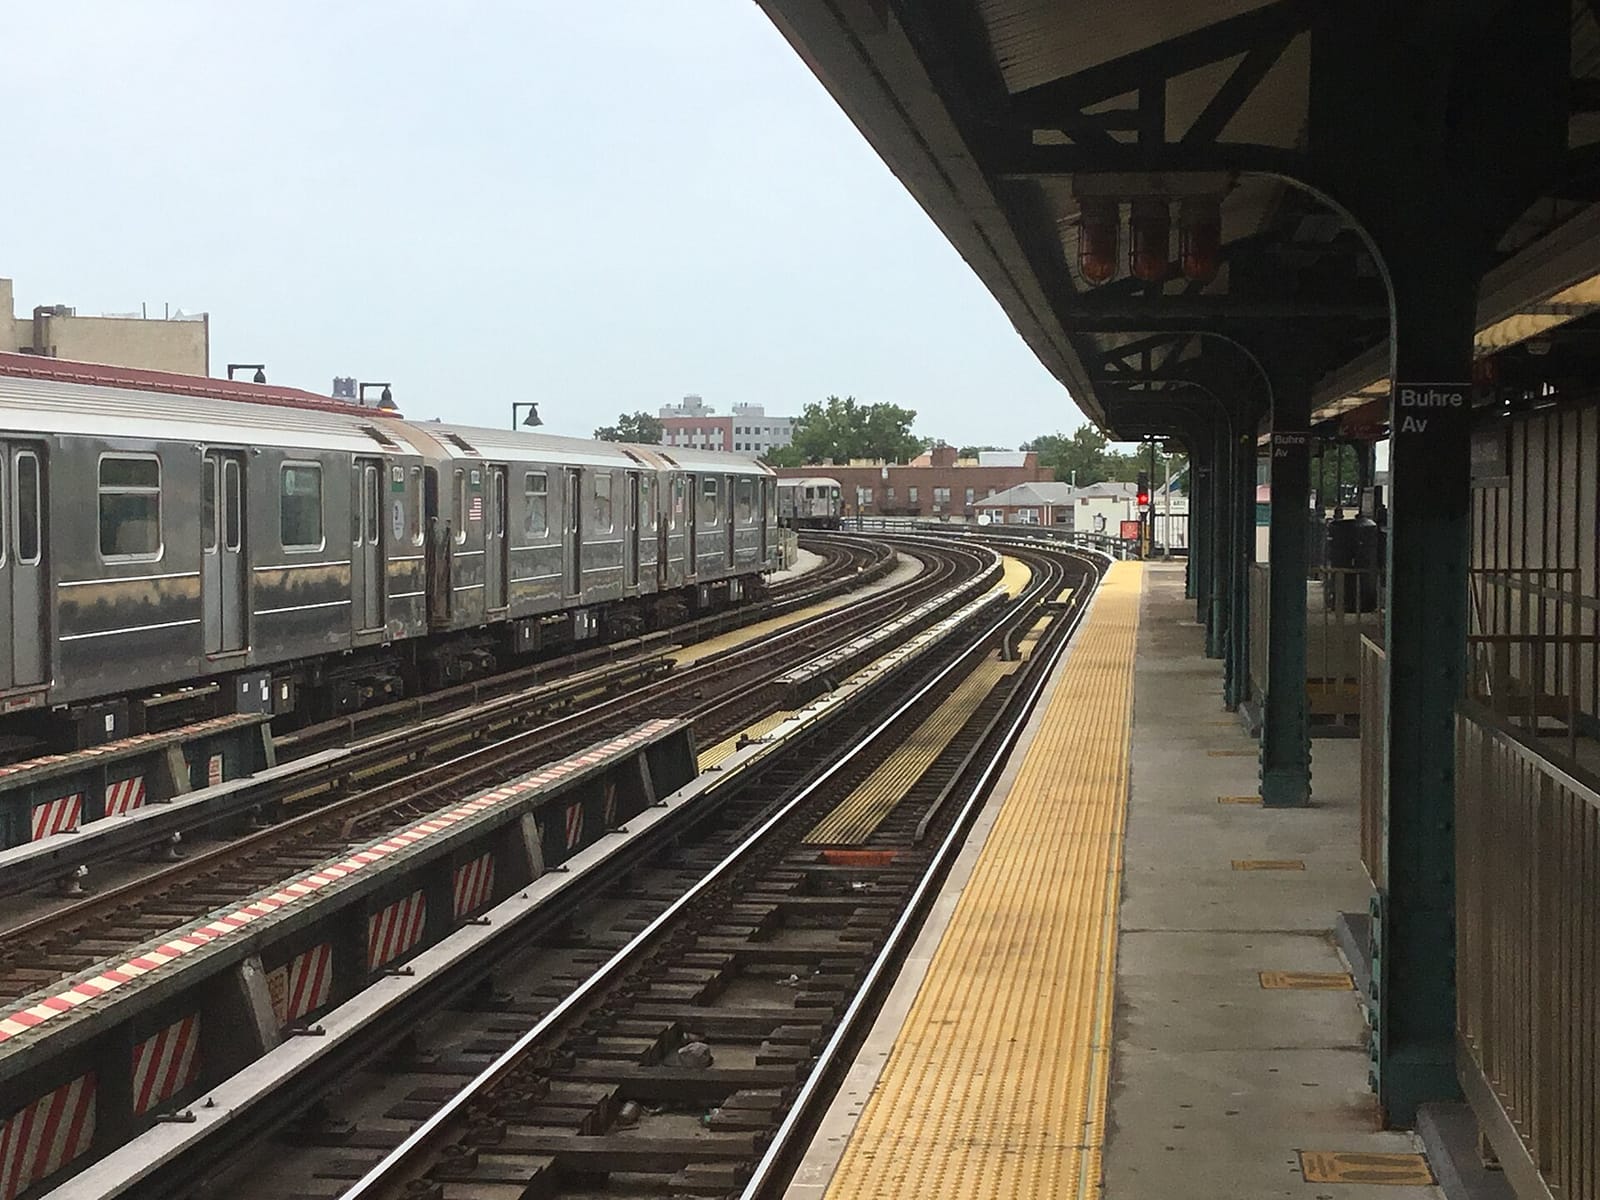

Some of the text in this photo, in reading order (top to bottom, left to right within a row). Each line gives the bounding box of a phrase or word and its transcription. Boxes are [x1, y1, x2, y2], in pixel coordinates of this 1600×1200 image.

[1401, 389, 1463, 407] Buhre
[1401, 415, 1428, 433] Av
[1274, 434, 1305, 444] Buhre
[1274, 449, 1289, 457] Av
